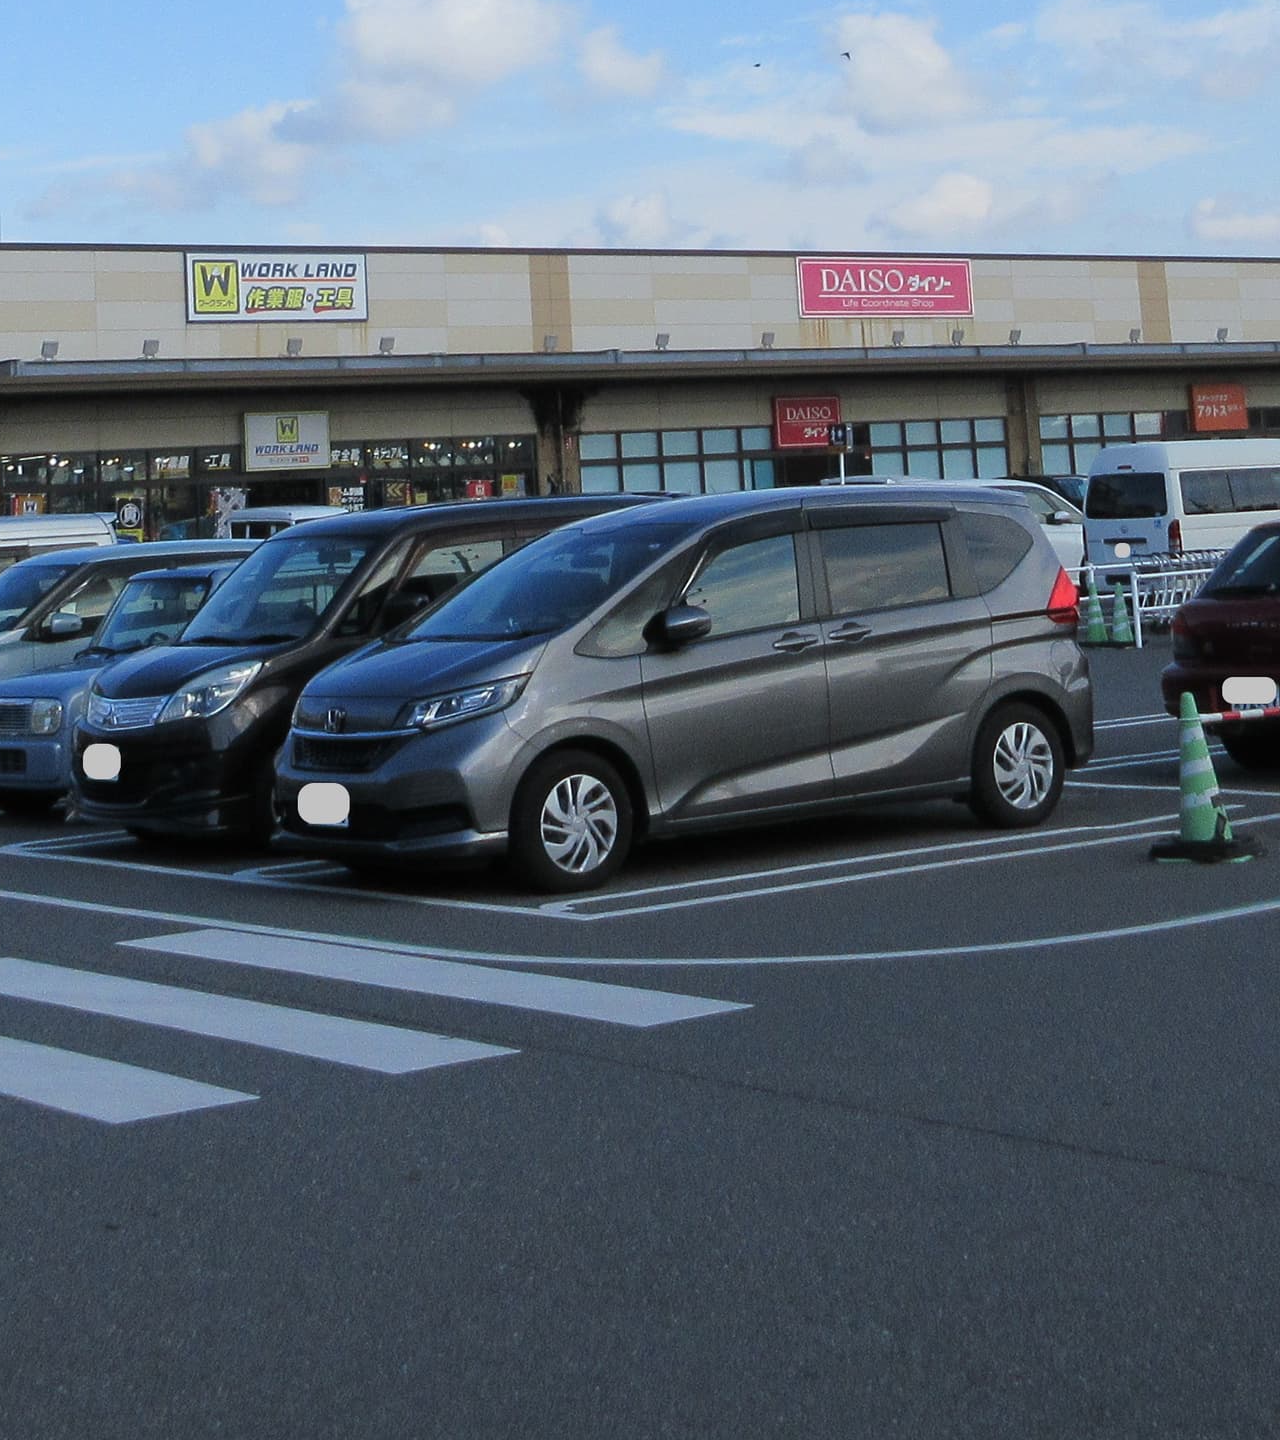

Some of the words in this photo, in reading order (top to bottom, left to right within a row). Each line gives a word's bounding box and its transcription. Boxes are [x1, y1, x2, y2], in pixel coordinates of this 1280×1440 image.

[240, 263, 298, 278] WORK
[303, 263, 358, 278] LAND
[200, 265, 232, 297] W
[820, 268, 904, 294] DAISO
[907, 274, 952, 293] ダイソー
[842, 298, 859, 308] Life
[861, 299, 909, 308] Coordinate
[911, 299, 935, 309] Shop
[786, 406, 831, 420] DAISO
[280, 419, 299, 435] W
[255, 445, 286, 453] WORK
[289, 444, 319, 452] LAND
